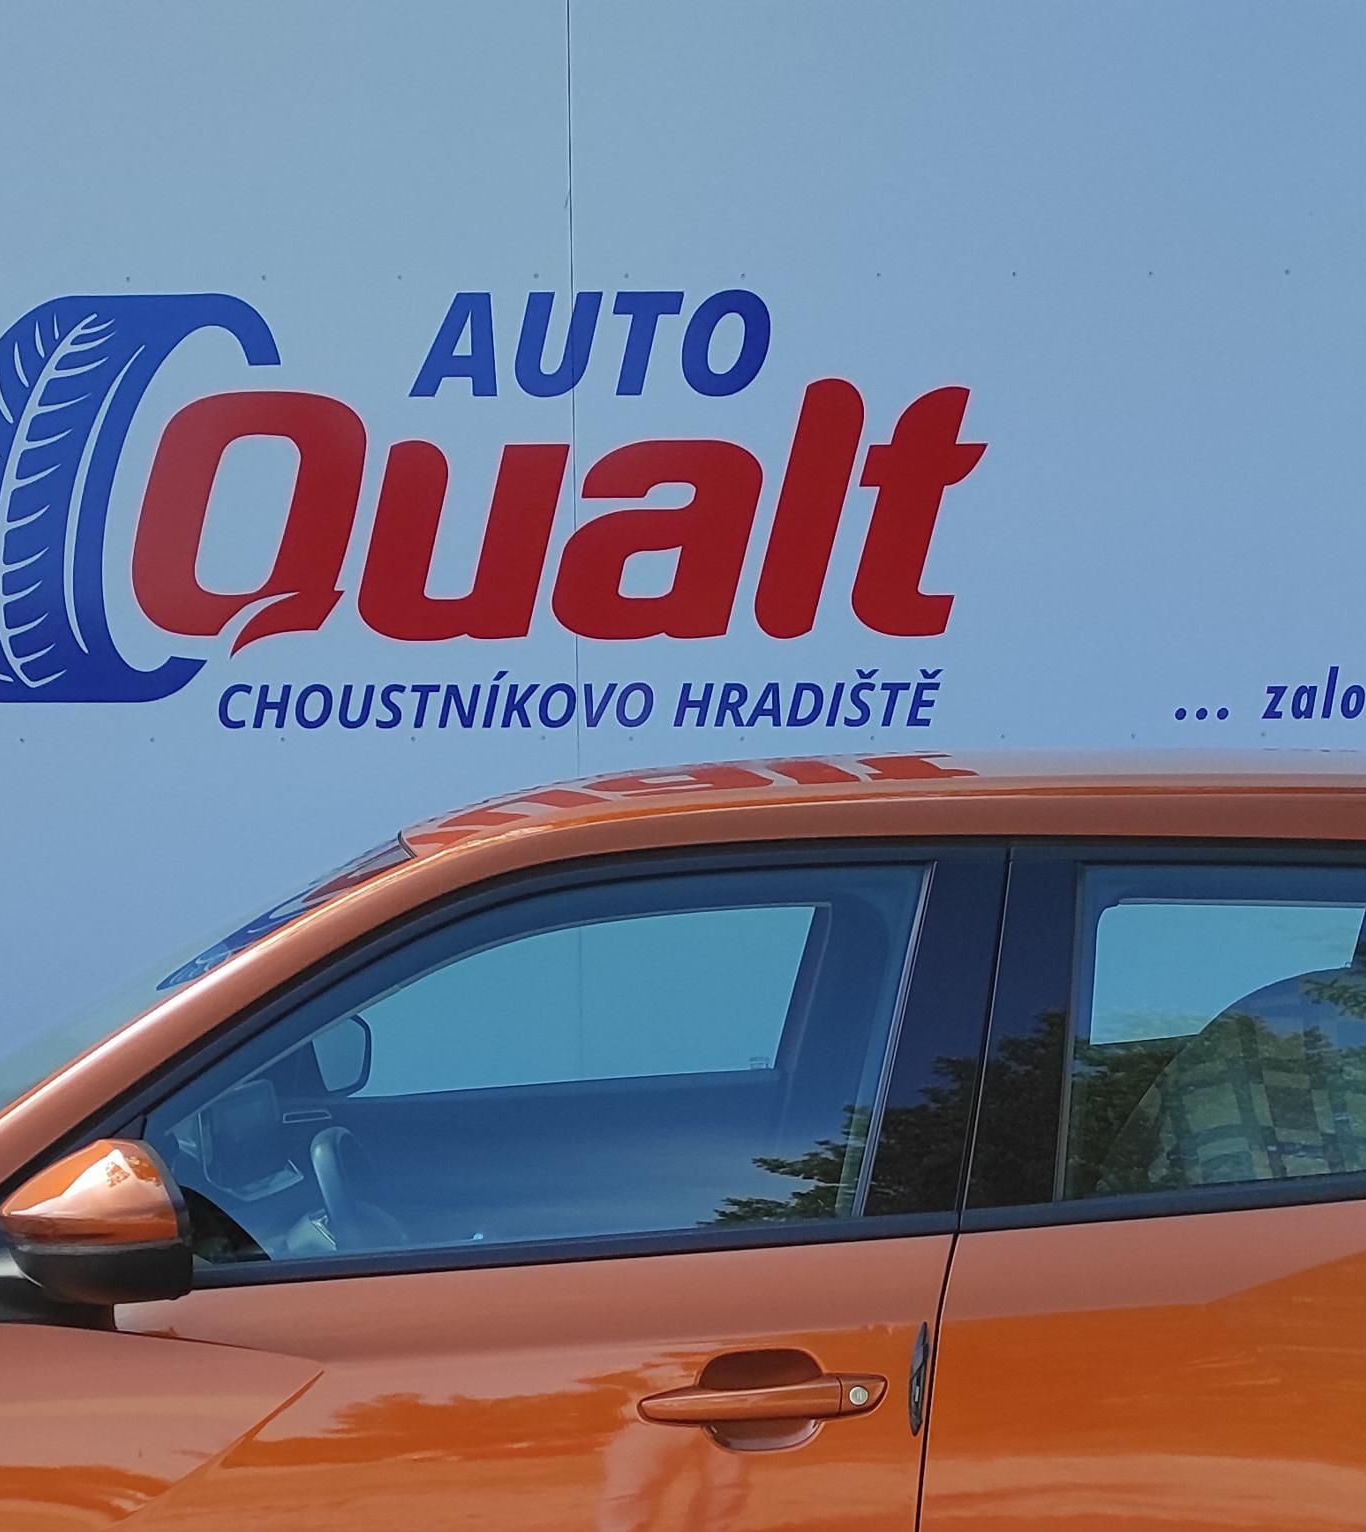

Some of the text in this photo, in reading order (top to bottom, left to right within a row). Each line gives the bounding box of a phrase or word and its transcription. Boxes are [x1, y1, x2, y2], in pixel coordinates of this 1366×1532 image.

[408, 290, 771, 398] AUTO
[130, 378, 987, 656] Qualt
[217, 668, 944, 730] CHOUSTNÍKOVO HRADIŠTĚ
